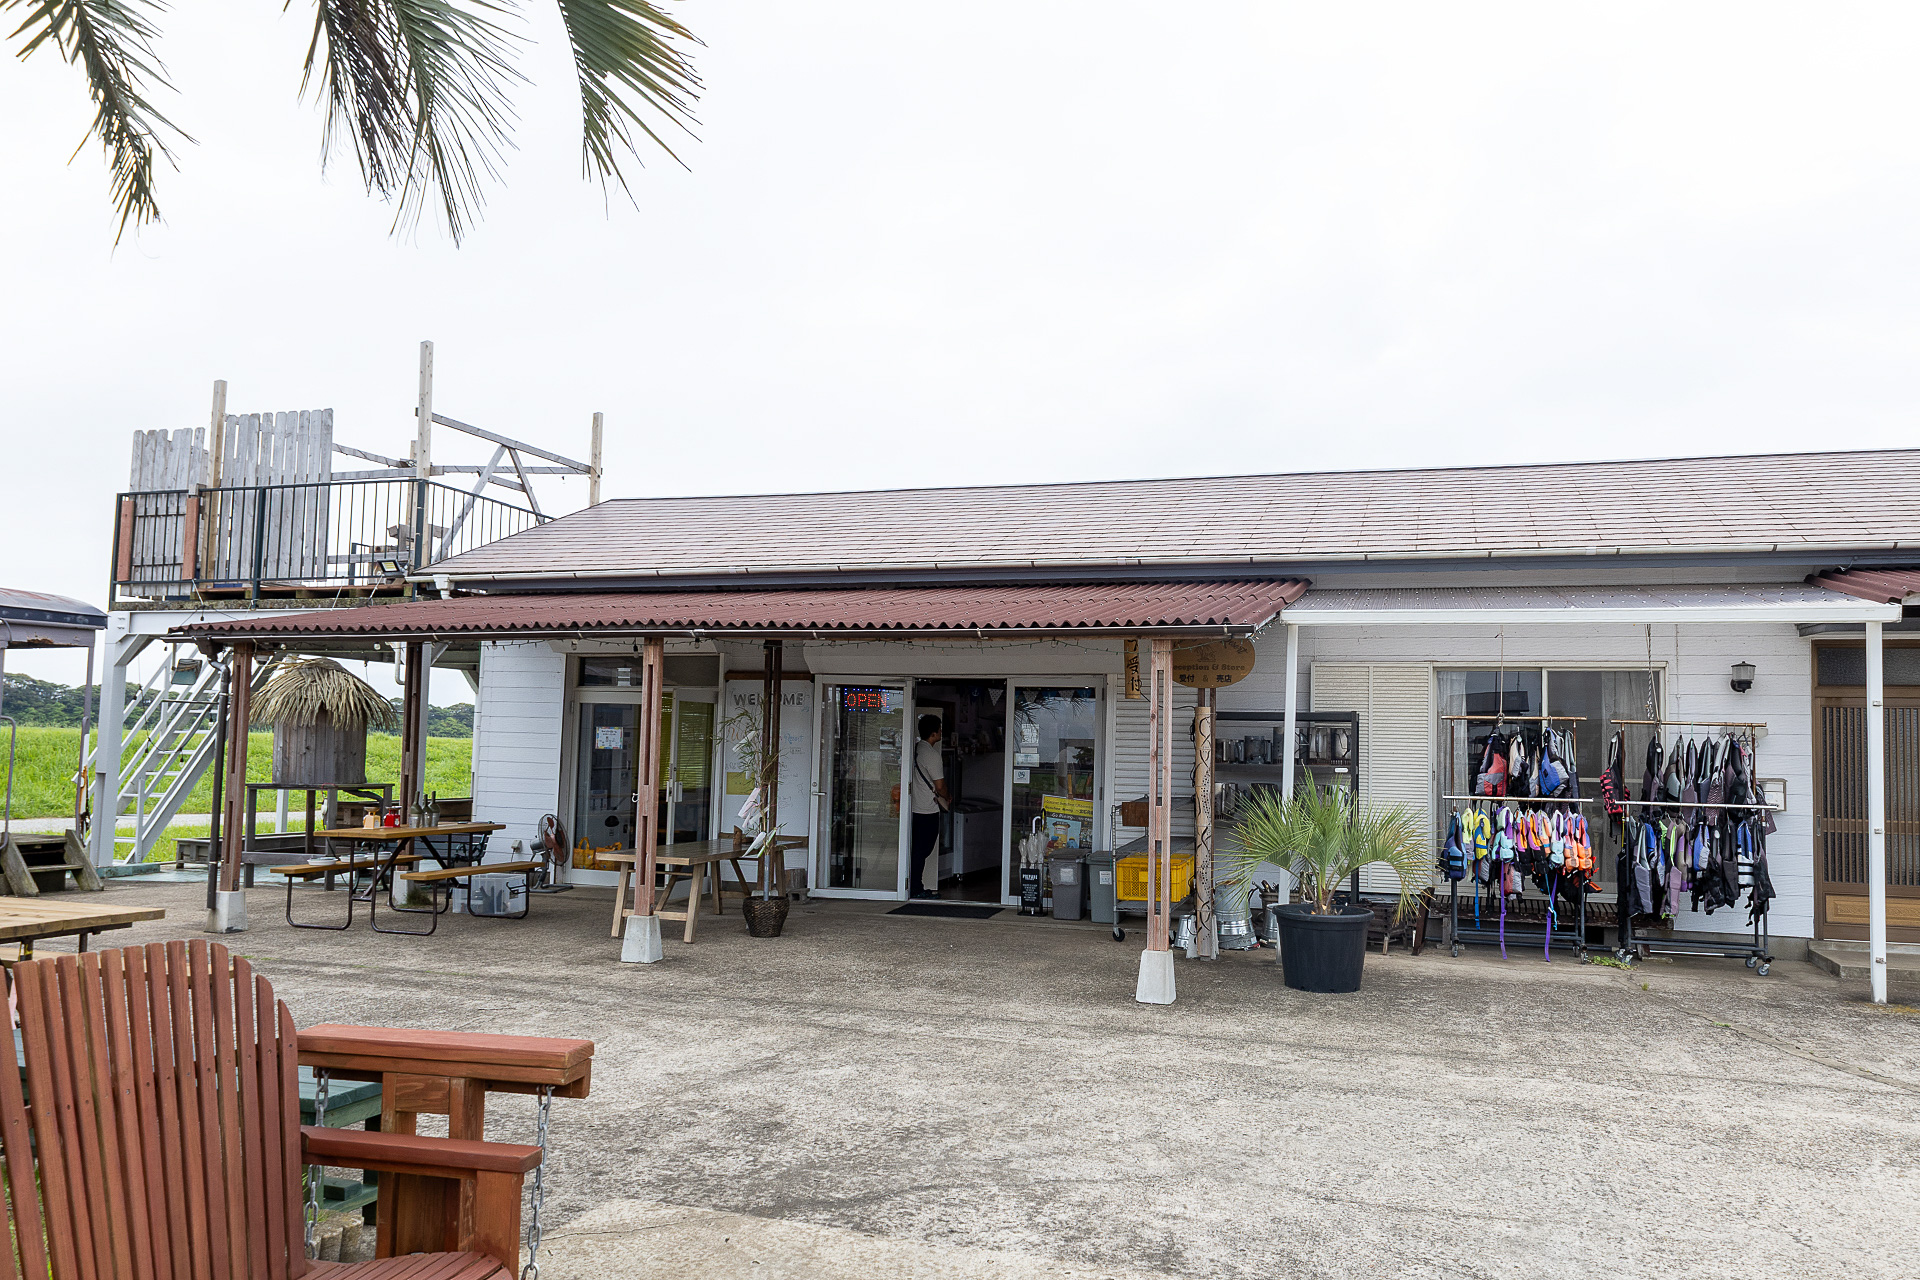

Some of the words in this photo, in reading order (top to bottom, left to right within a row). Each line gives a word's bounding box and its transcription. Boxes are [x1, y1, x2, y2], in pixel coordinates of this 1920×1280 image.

[1173, 663, 1209, 672] eception
[1211, 663, 1219, 671] &
[1221, 663, 1246, 671] Store
[1179, 673, 1195, 683] 受付
[1202, 674, 1209, 683] &
[1216, 674, 1232, 683] 売店
[733, 692, 804, 706] WELME
[846, 693, 887, 708] OPEN
